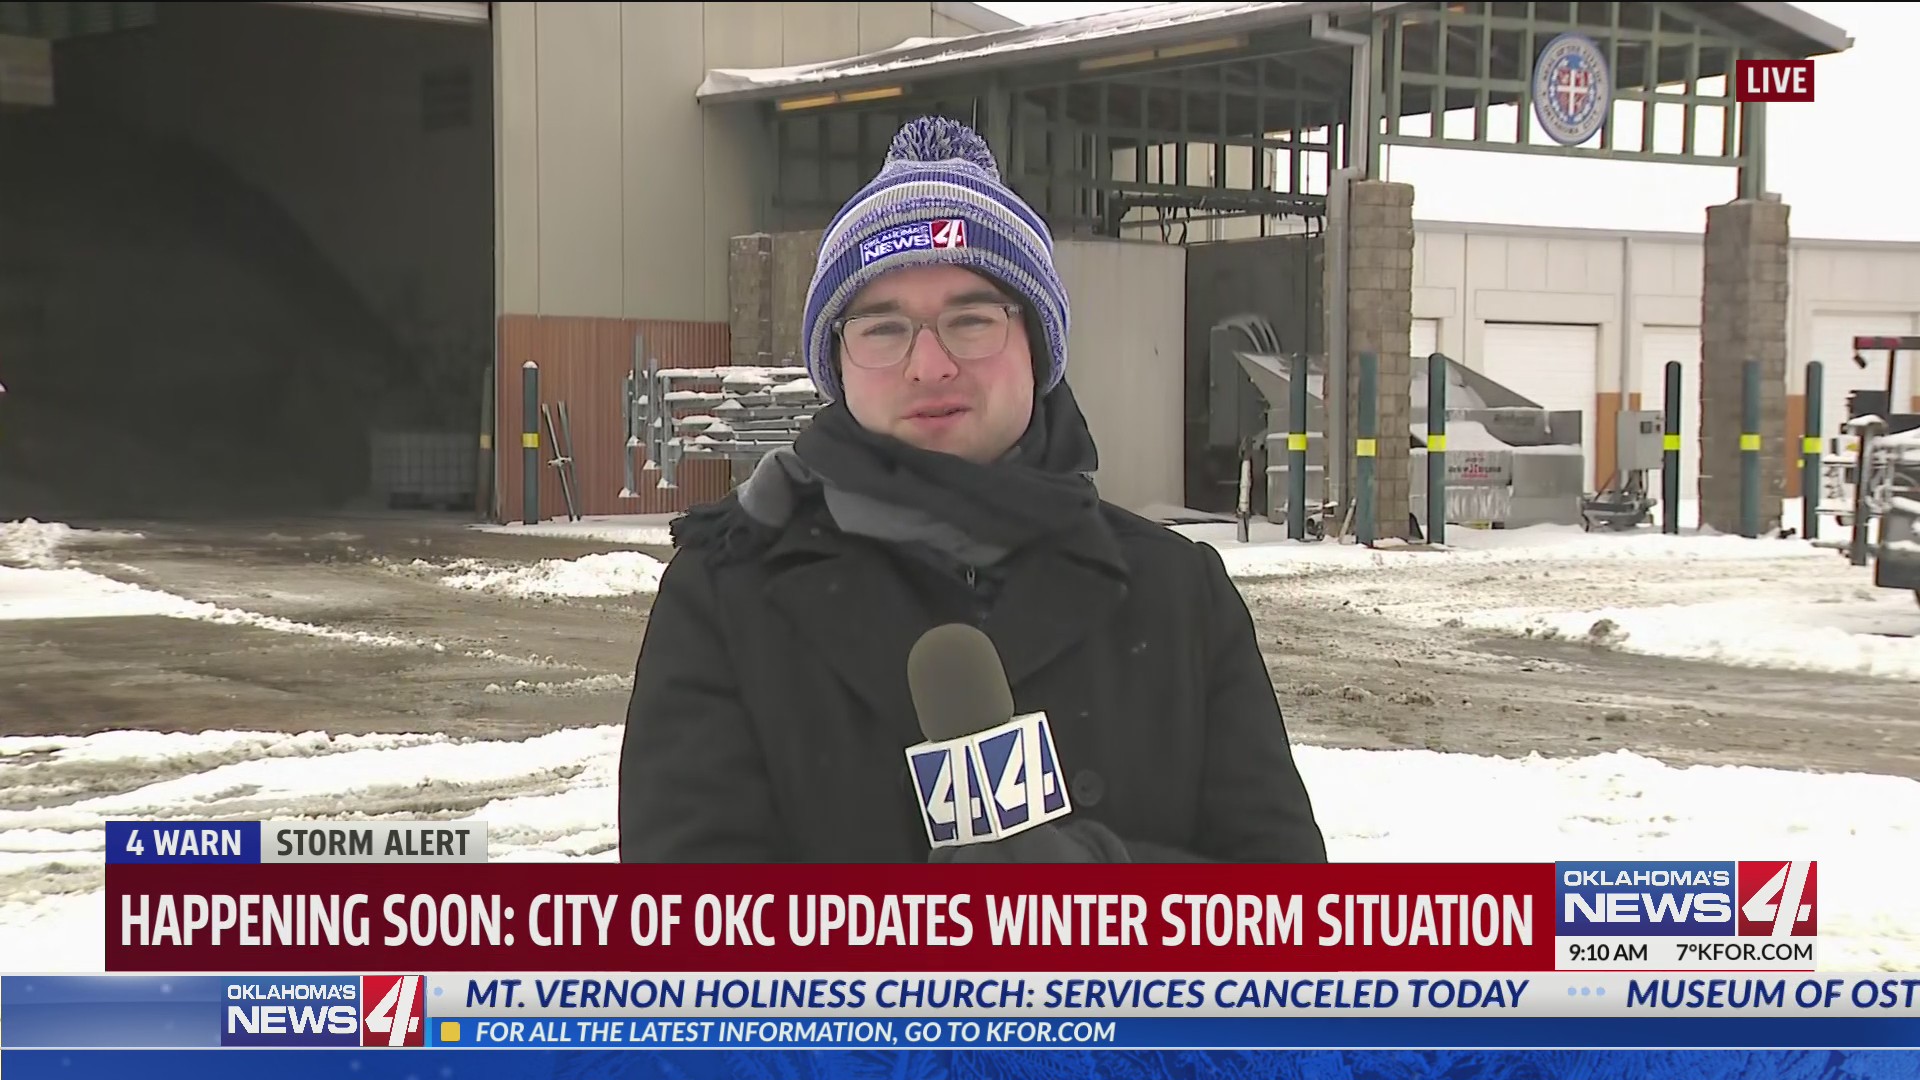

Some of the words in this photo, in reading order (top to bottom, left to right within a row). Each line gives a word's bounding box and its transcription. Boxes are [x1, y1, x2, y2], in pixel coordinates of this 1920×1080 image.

[864, 234, 931, 262] NEWS
[932, 219, 963, 249] 4
[927, 743, 982, 843] 4
[994, 714, 1055, 824] 4
